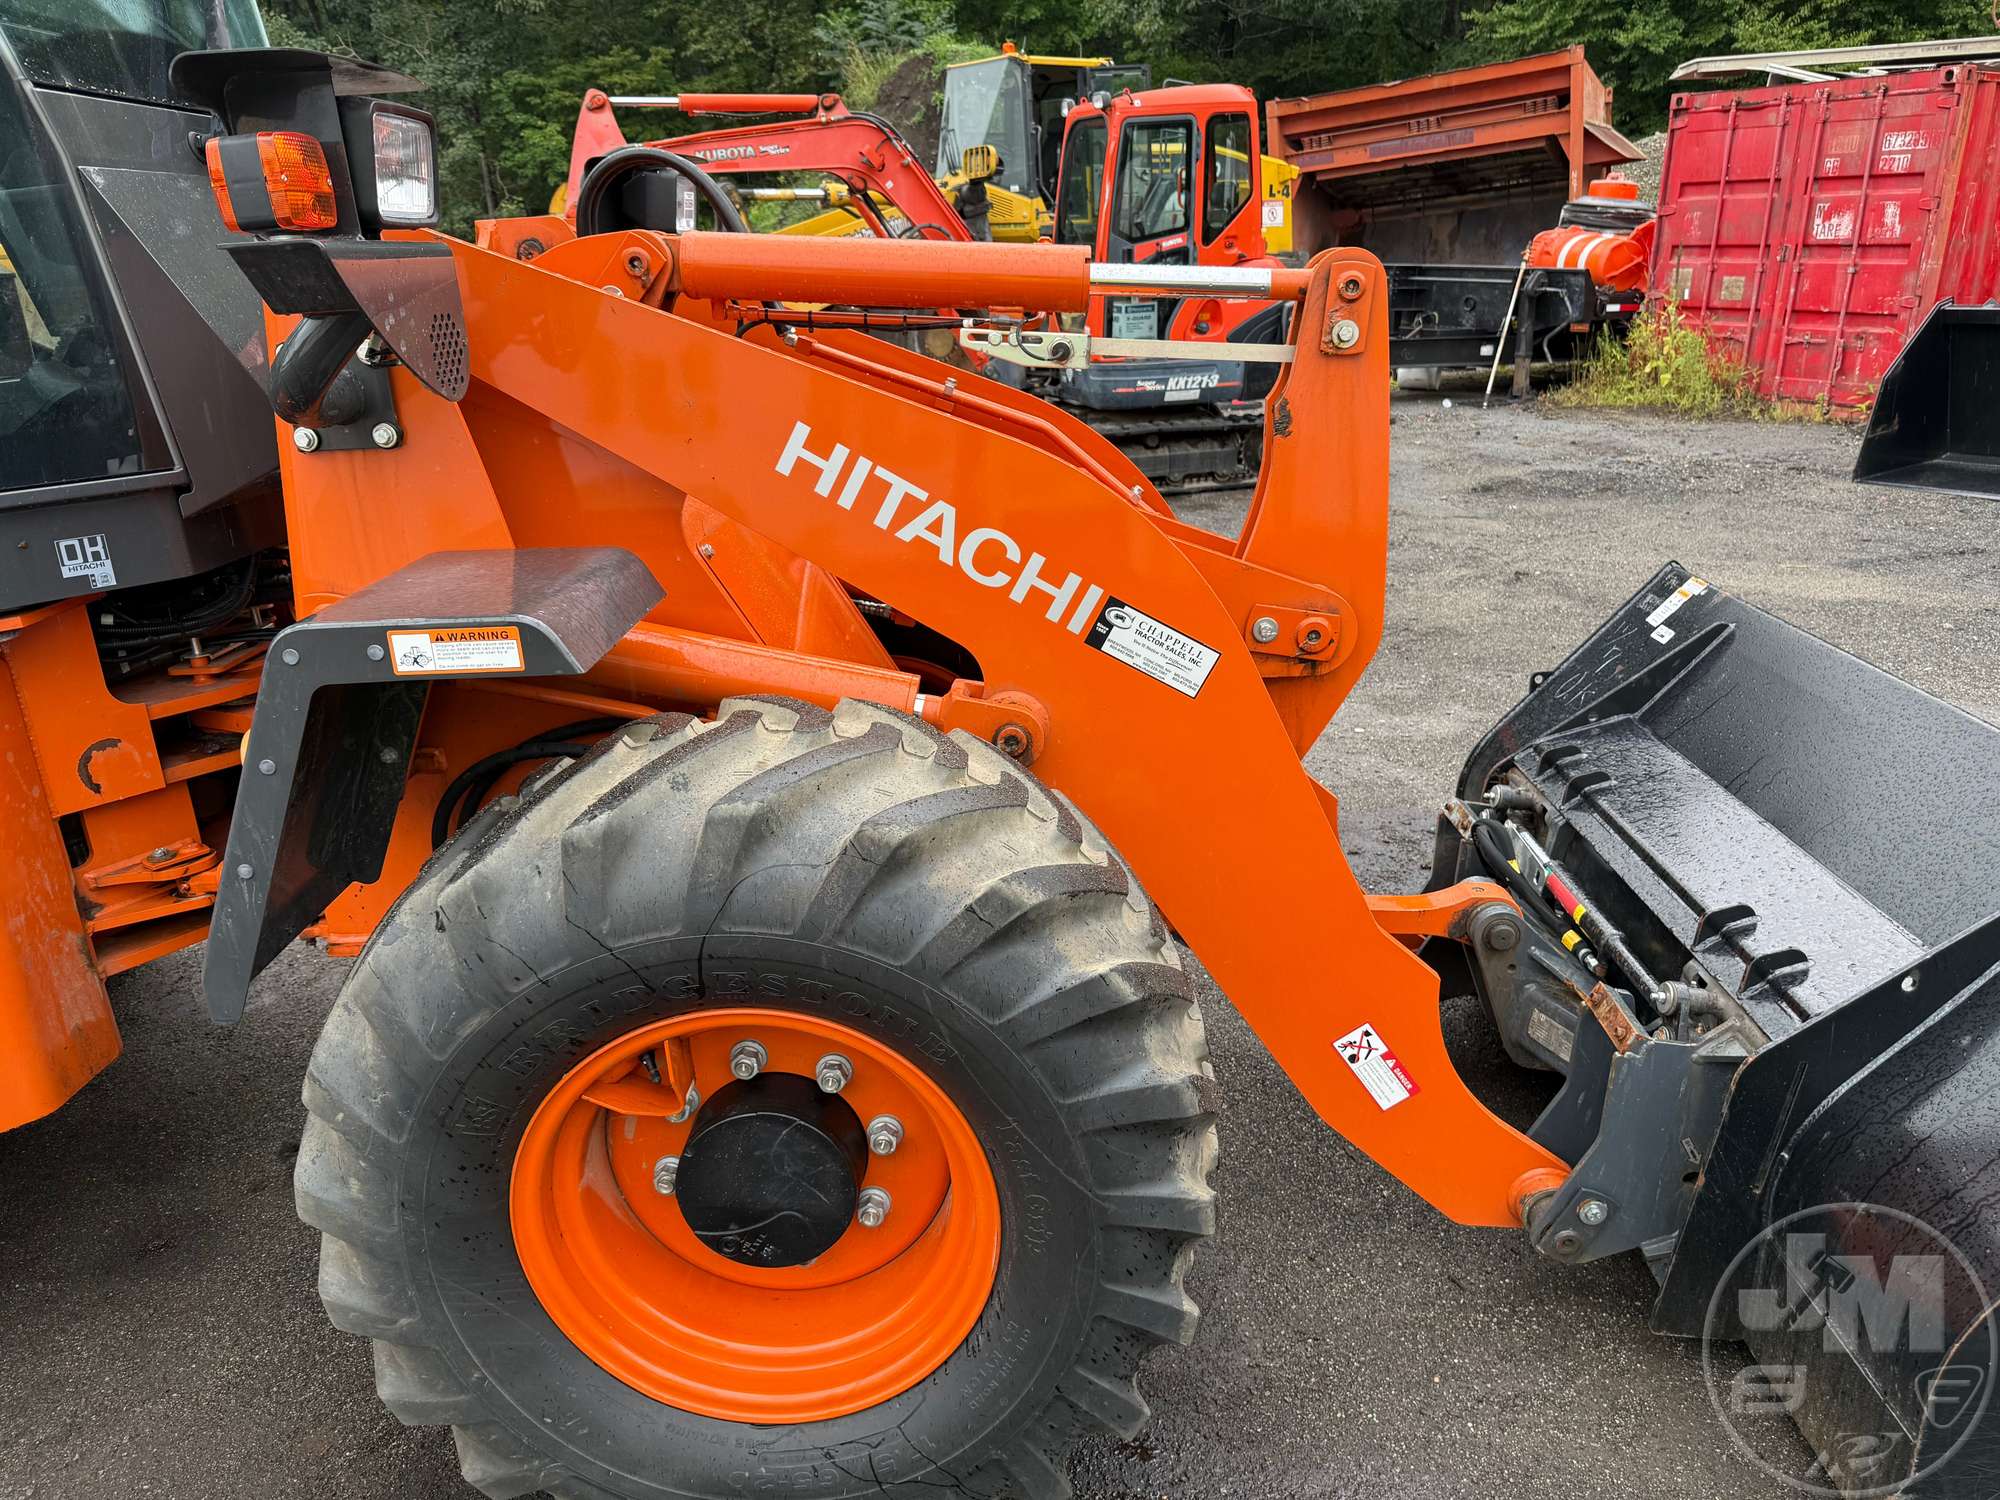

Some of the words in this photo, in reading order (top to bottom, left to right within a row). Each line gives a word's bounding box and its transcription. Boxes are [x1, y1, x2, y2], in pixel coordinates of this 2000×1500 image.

[695, 146, 756, 162] KUBOTA
[774, 420, 1105, 636] HITACHI
[68, 561, 107, 573] HITACHI
[447, 630, 509, 642] WARNING
[1134, 628, 1166, 649] TRACTOR
[1138, 620, 1204, 661] CHAPPELL
[498, 970, 959, 1080] BRIDGESTONE
